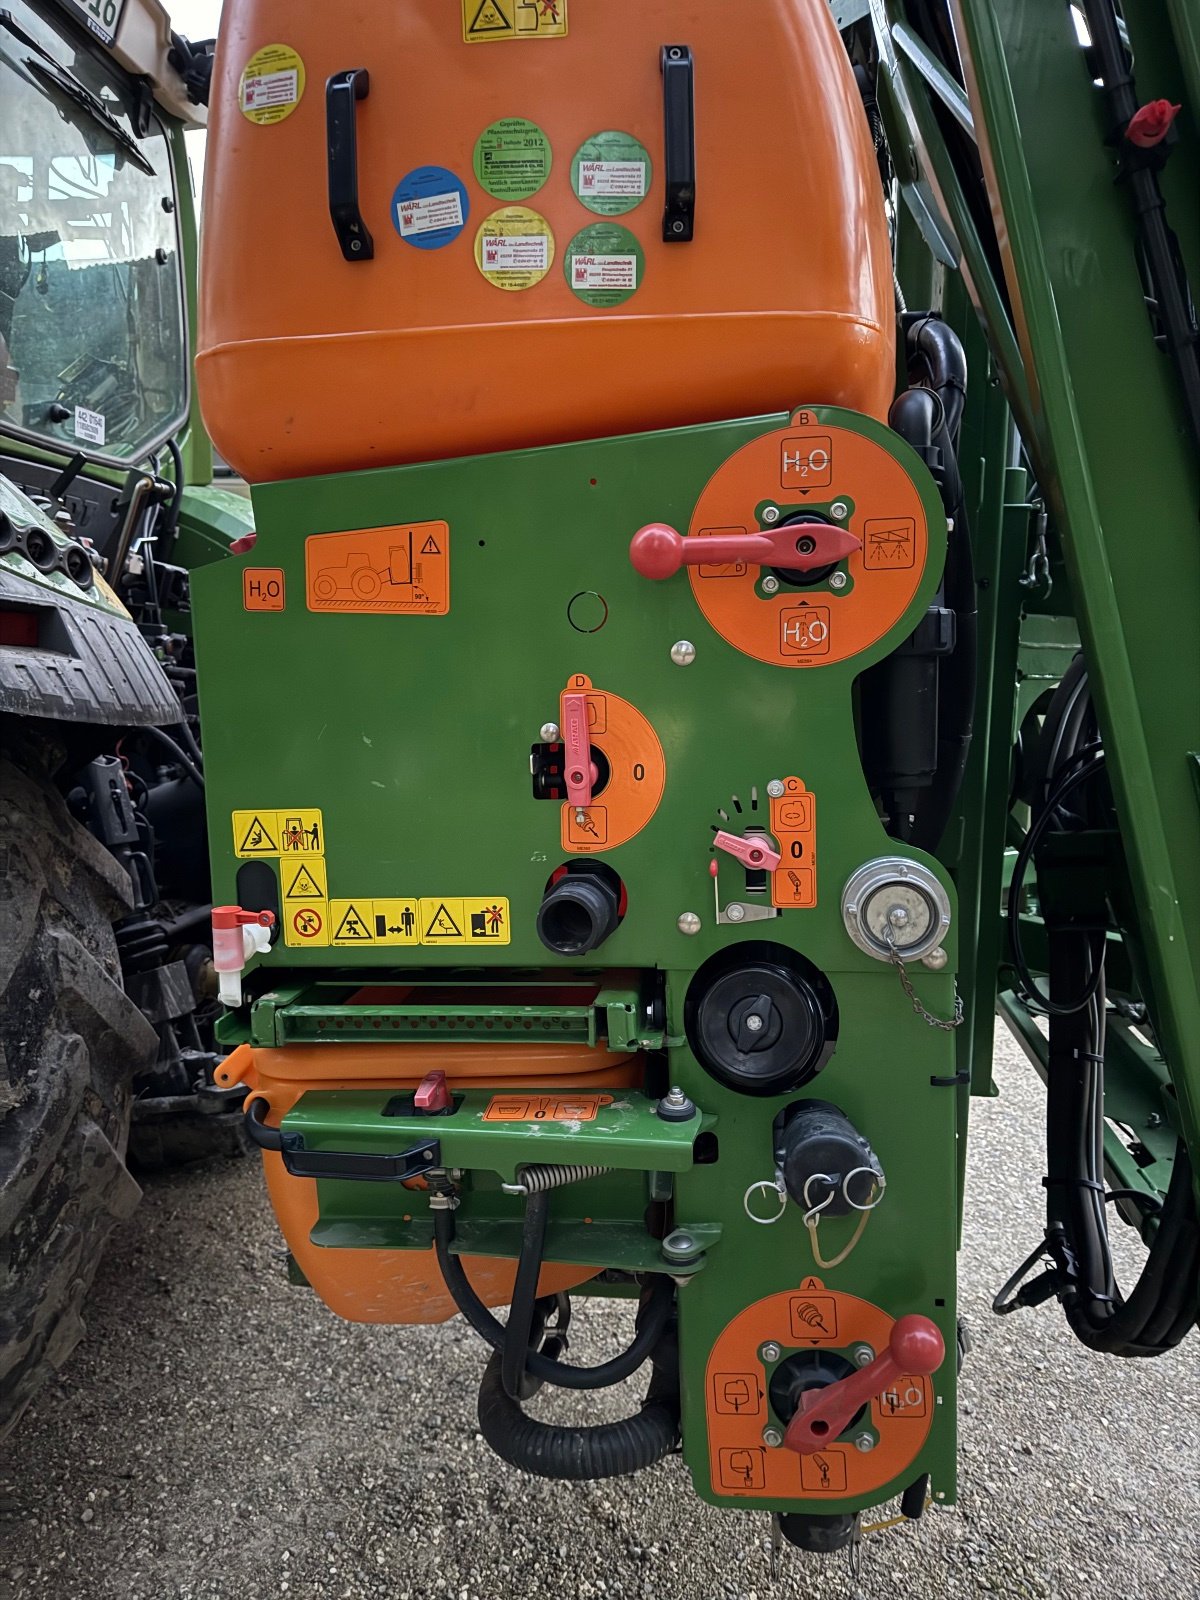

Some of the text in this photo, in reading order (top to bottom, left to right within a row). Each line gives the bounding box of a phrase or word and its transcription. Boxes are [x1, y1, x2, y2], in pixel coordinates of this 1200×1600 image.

[523, 138, 543, 147] 2012
[800, 413, 809, 424] B
[783, 449, 828, 477] H2O
[249, 580, 280, 601] H2O
[783, 621, 828, 647] H2O
[576, 675, 585, 687] D
[633, 763, 645, 781] 0
[787, 779, 798, 790] C
[790, 840, 803, 859] 0
[534, 1110, 546, 1118] 0
[807, 1279, 817, 1289] A
[881, 1387, 922, 1410] H2O
